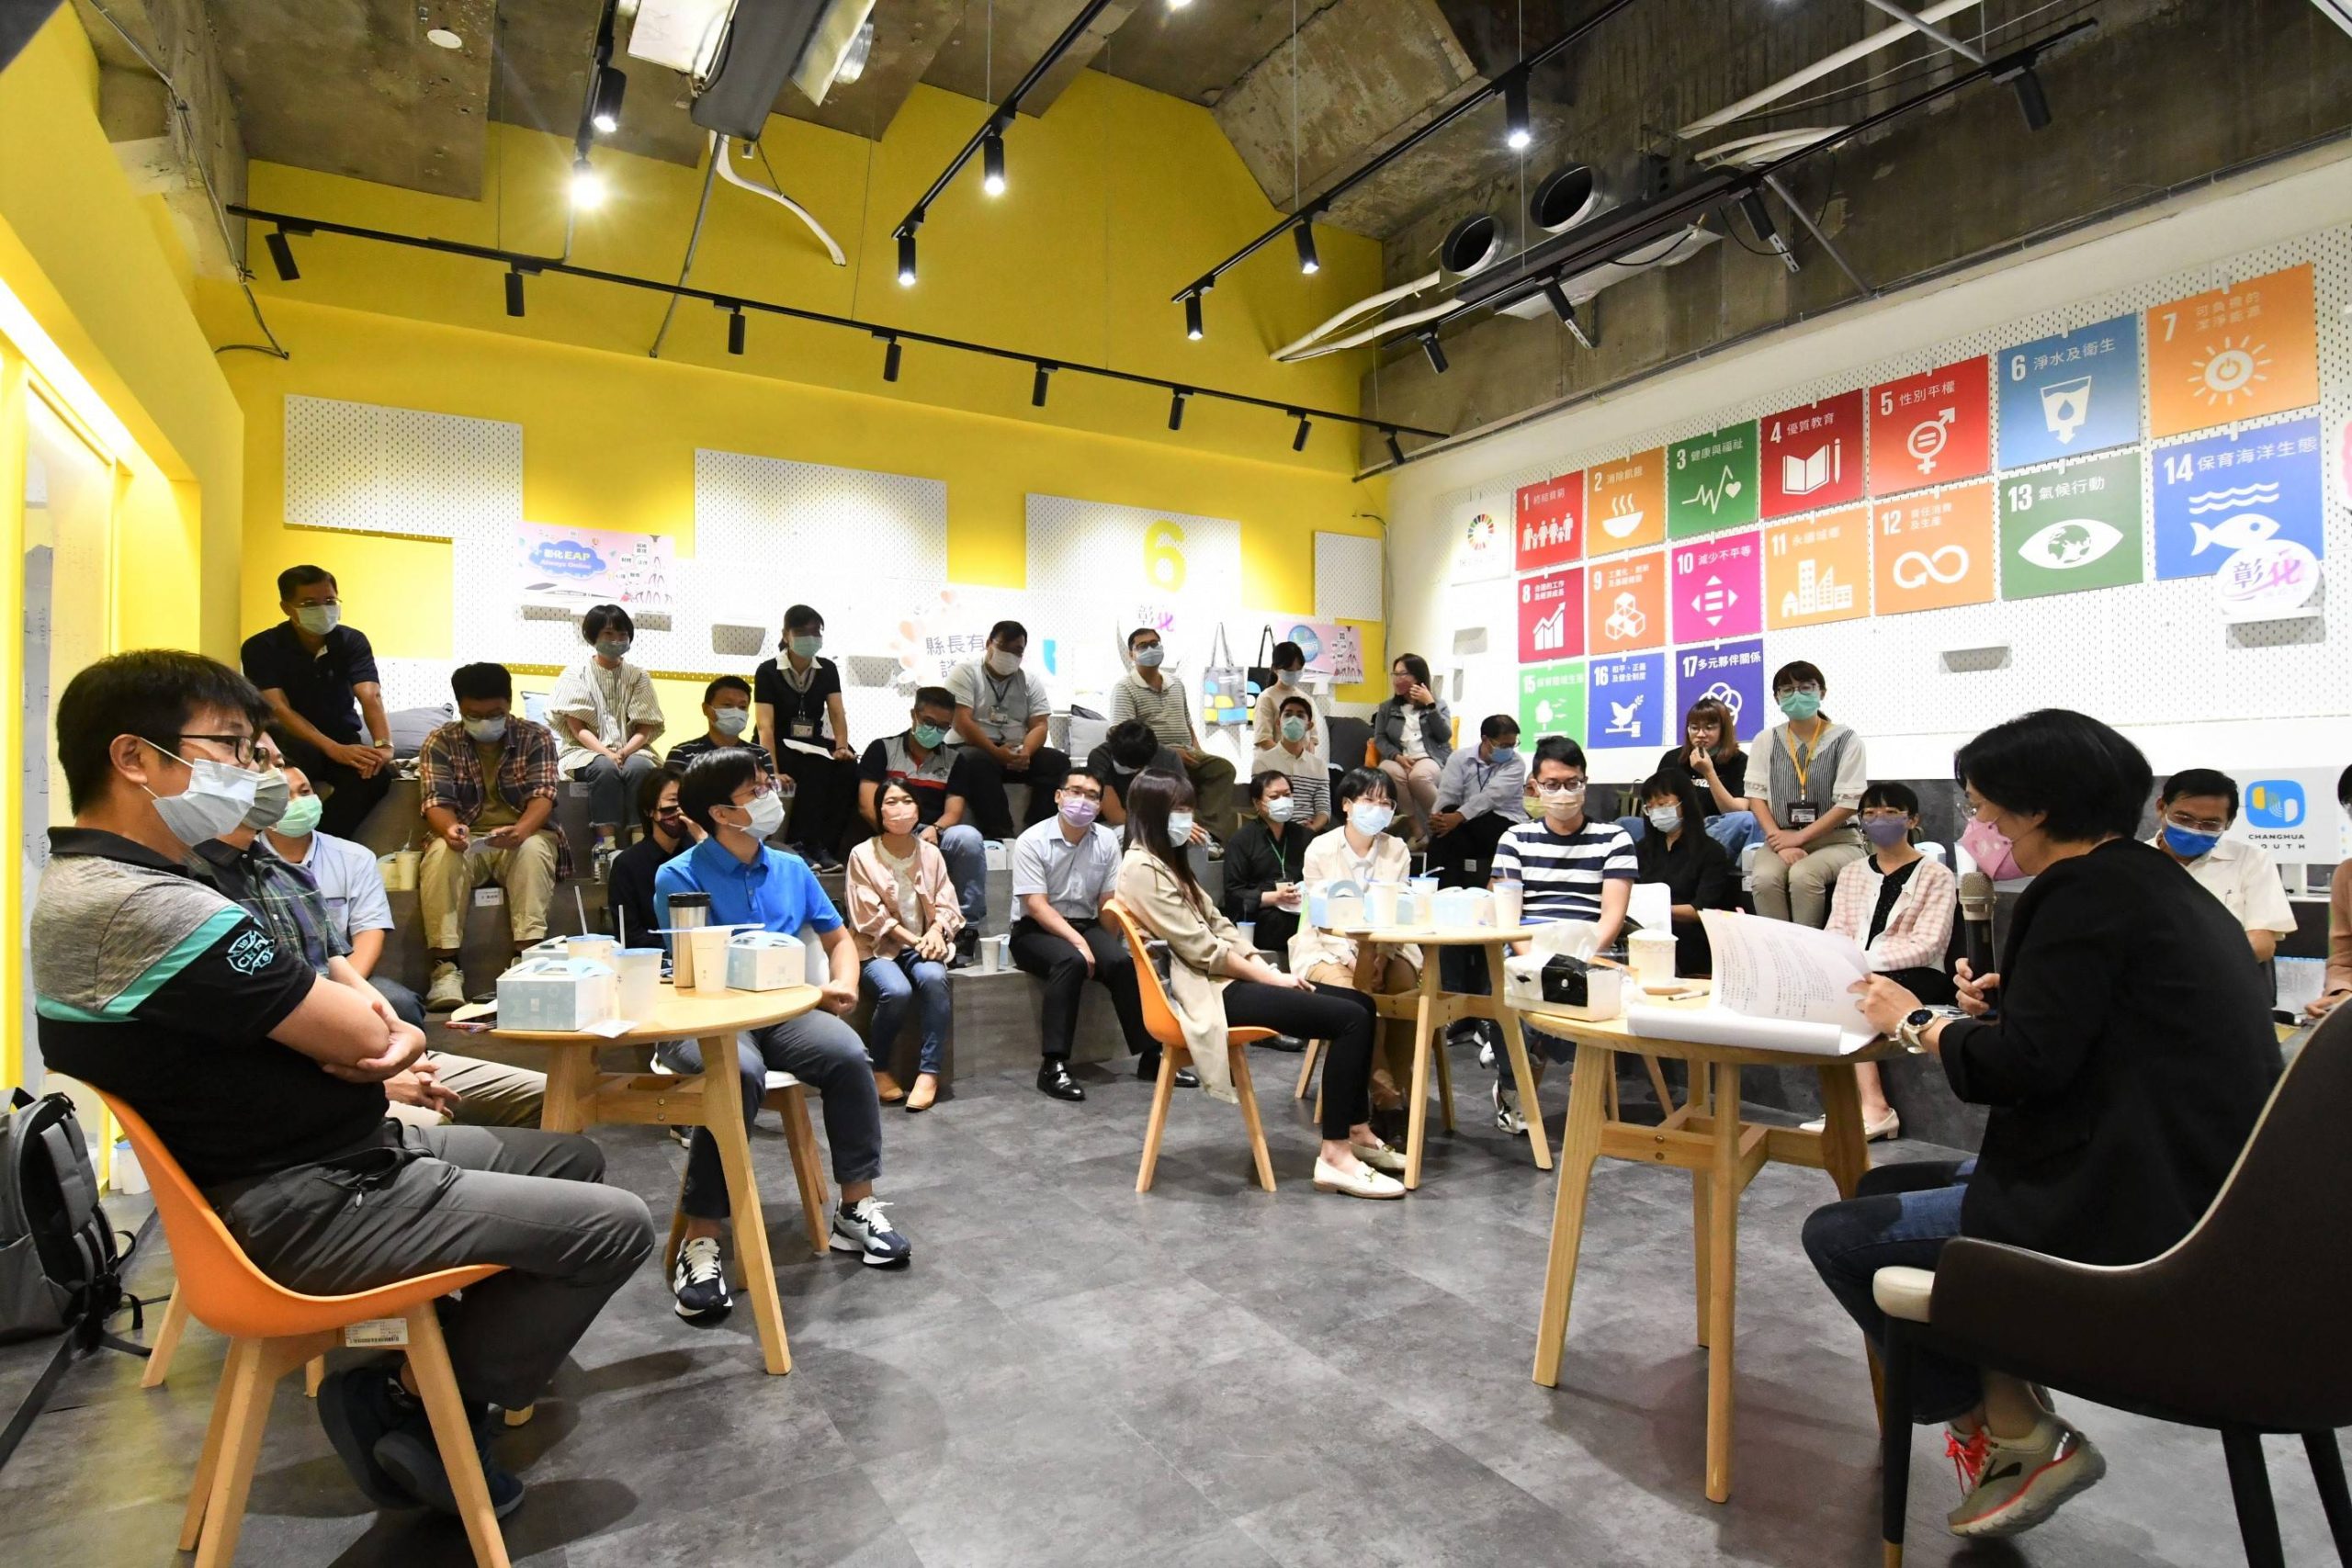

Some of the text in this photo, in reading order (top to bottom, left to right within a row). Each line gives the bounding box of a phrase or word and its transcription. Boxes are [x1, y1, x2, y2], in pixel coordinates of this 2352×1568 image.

[2162, 312, 2177, 342] 7
[2011, 337, 2116, 381] 6 淨水及衛生
[1881, 380, 1955, 416] 5 性別平權
[1770, 412, 1835, 443] 4 優質教育
[1676, 437, 1744, 469] 3 健康與福祉
[2164, 436, 2318, 485] 14 保育海洋生態
[1594, 472, 1602, 492] 2
[2008, 476, 2105, 513] 13 氣候行動
[1523, 493, 1529, 511] 1
[1882, 510, 1901, 536] 12
[564, 551, 591, 561] EAP
[1143, 519, 1187, 592] 6
[1771, 533, 1786, 557] 11
[1677, 545, 1752, 575] 10 減少不平等
[2233, 557, 2302, 589] 彰化
[1522, 584, 1531, 604] 8
[1594, 570, 1602, 591] 9
[925, 634, 986, 656] 縣長有
[1594, 665, 1609, 687] 16
[1682, 651, 1761, 678] 17 多元夥伴關係
[1523, 674, 1535, 694] 15
